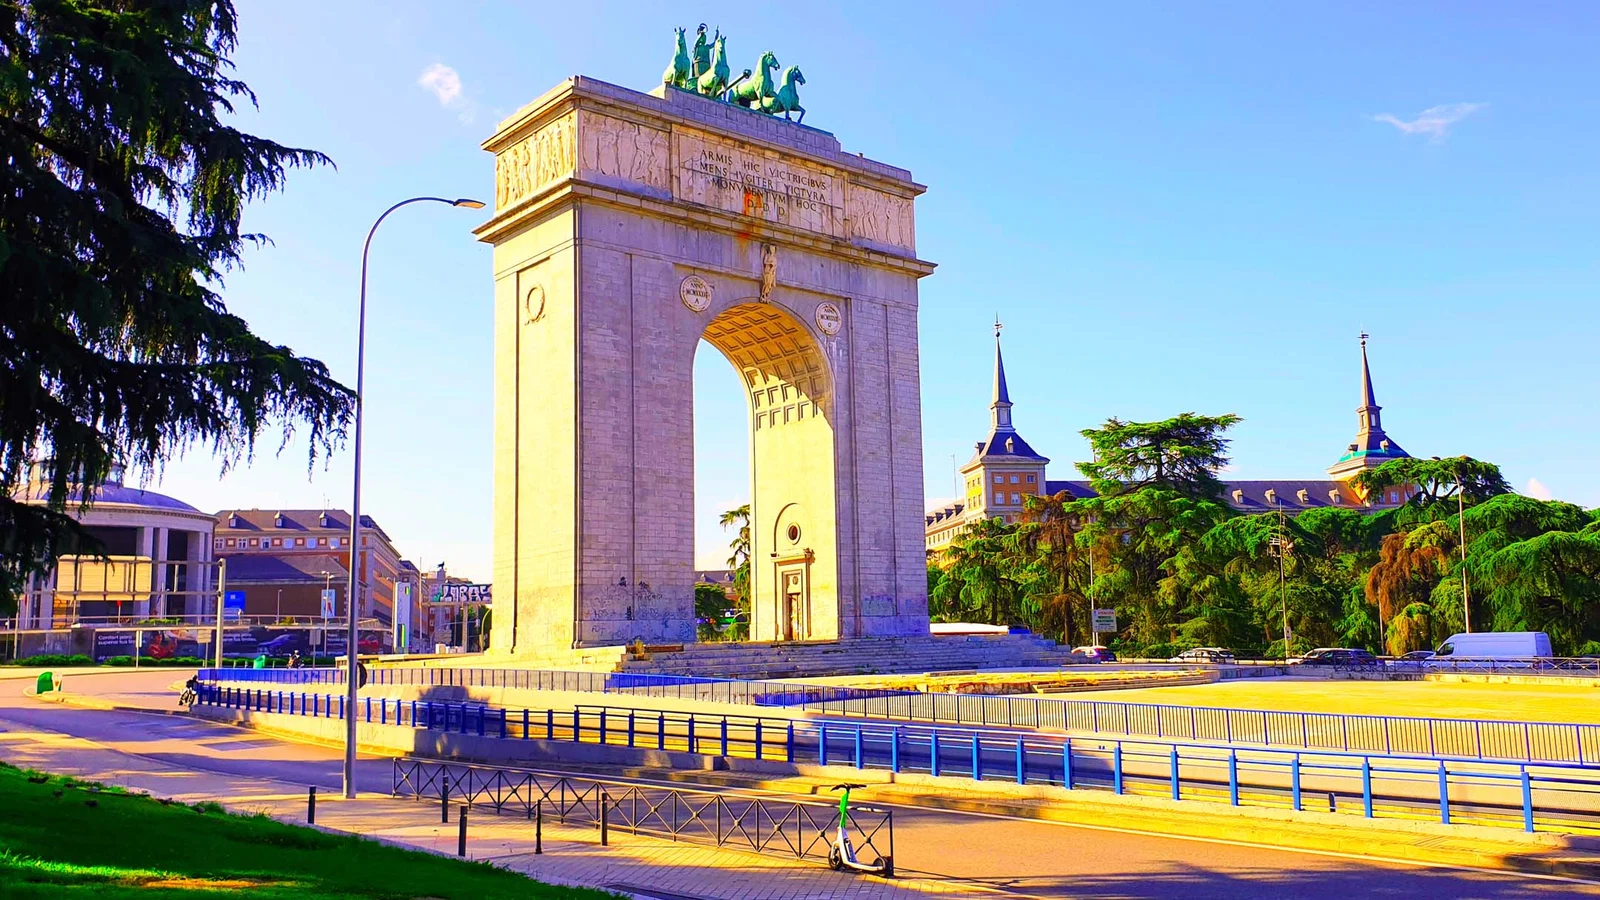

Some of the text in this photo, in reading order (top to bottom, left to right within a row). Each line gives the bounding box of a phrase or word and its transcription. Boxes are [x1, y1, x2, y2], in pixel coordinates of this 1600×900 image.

[700, 149, 733, 165] ARMIS
[743, 160, 760, 172] HIC
[700, 162, 728, 176] MENS
[796, 199, 817, 211] HOC
